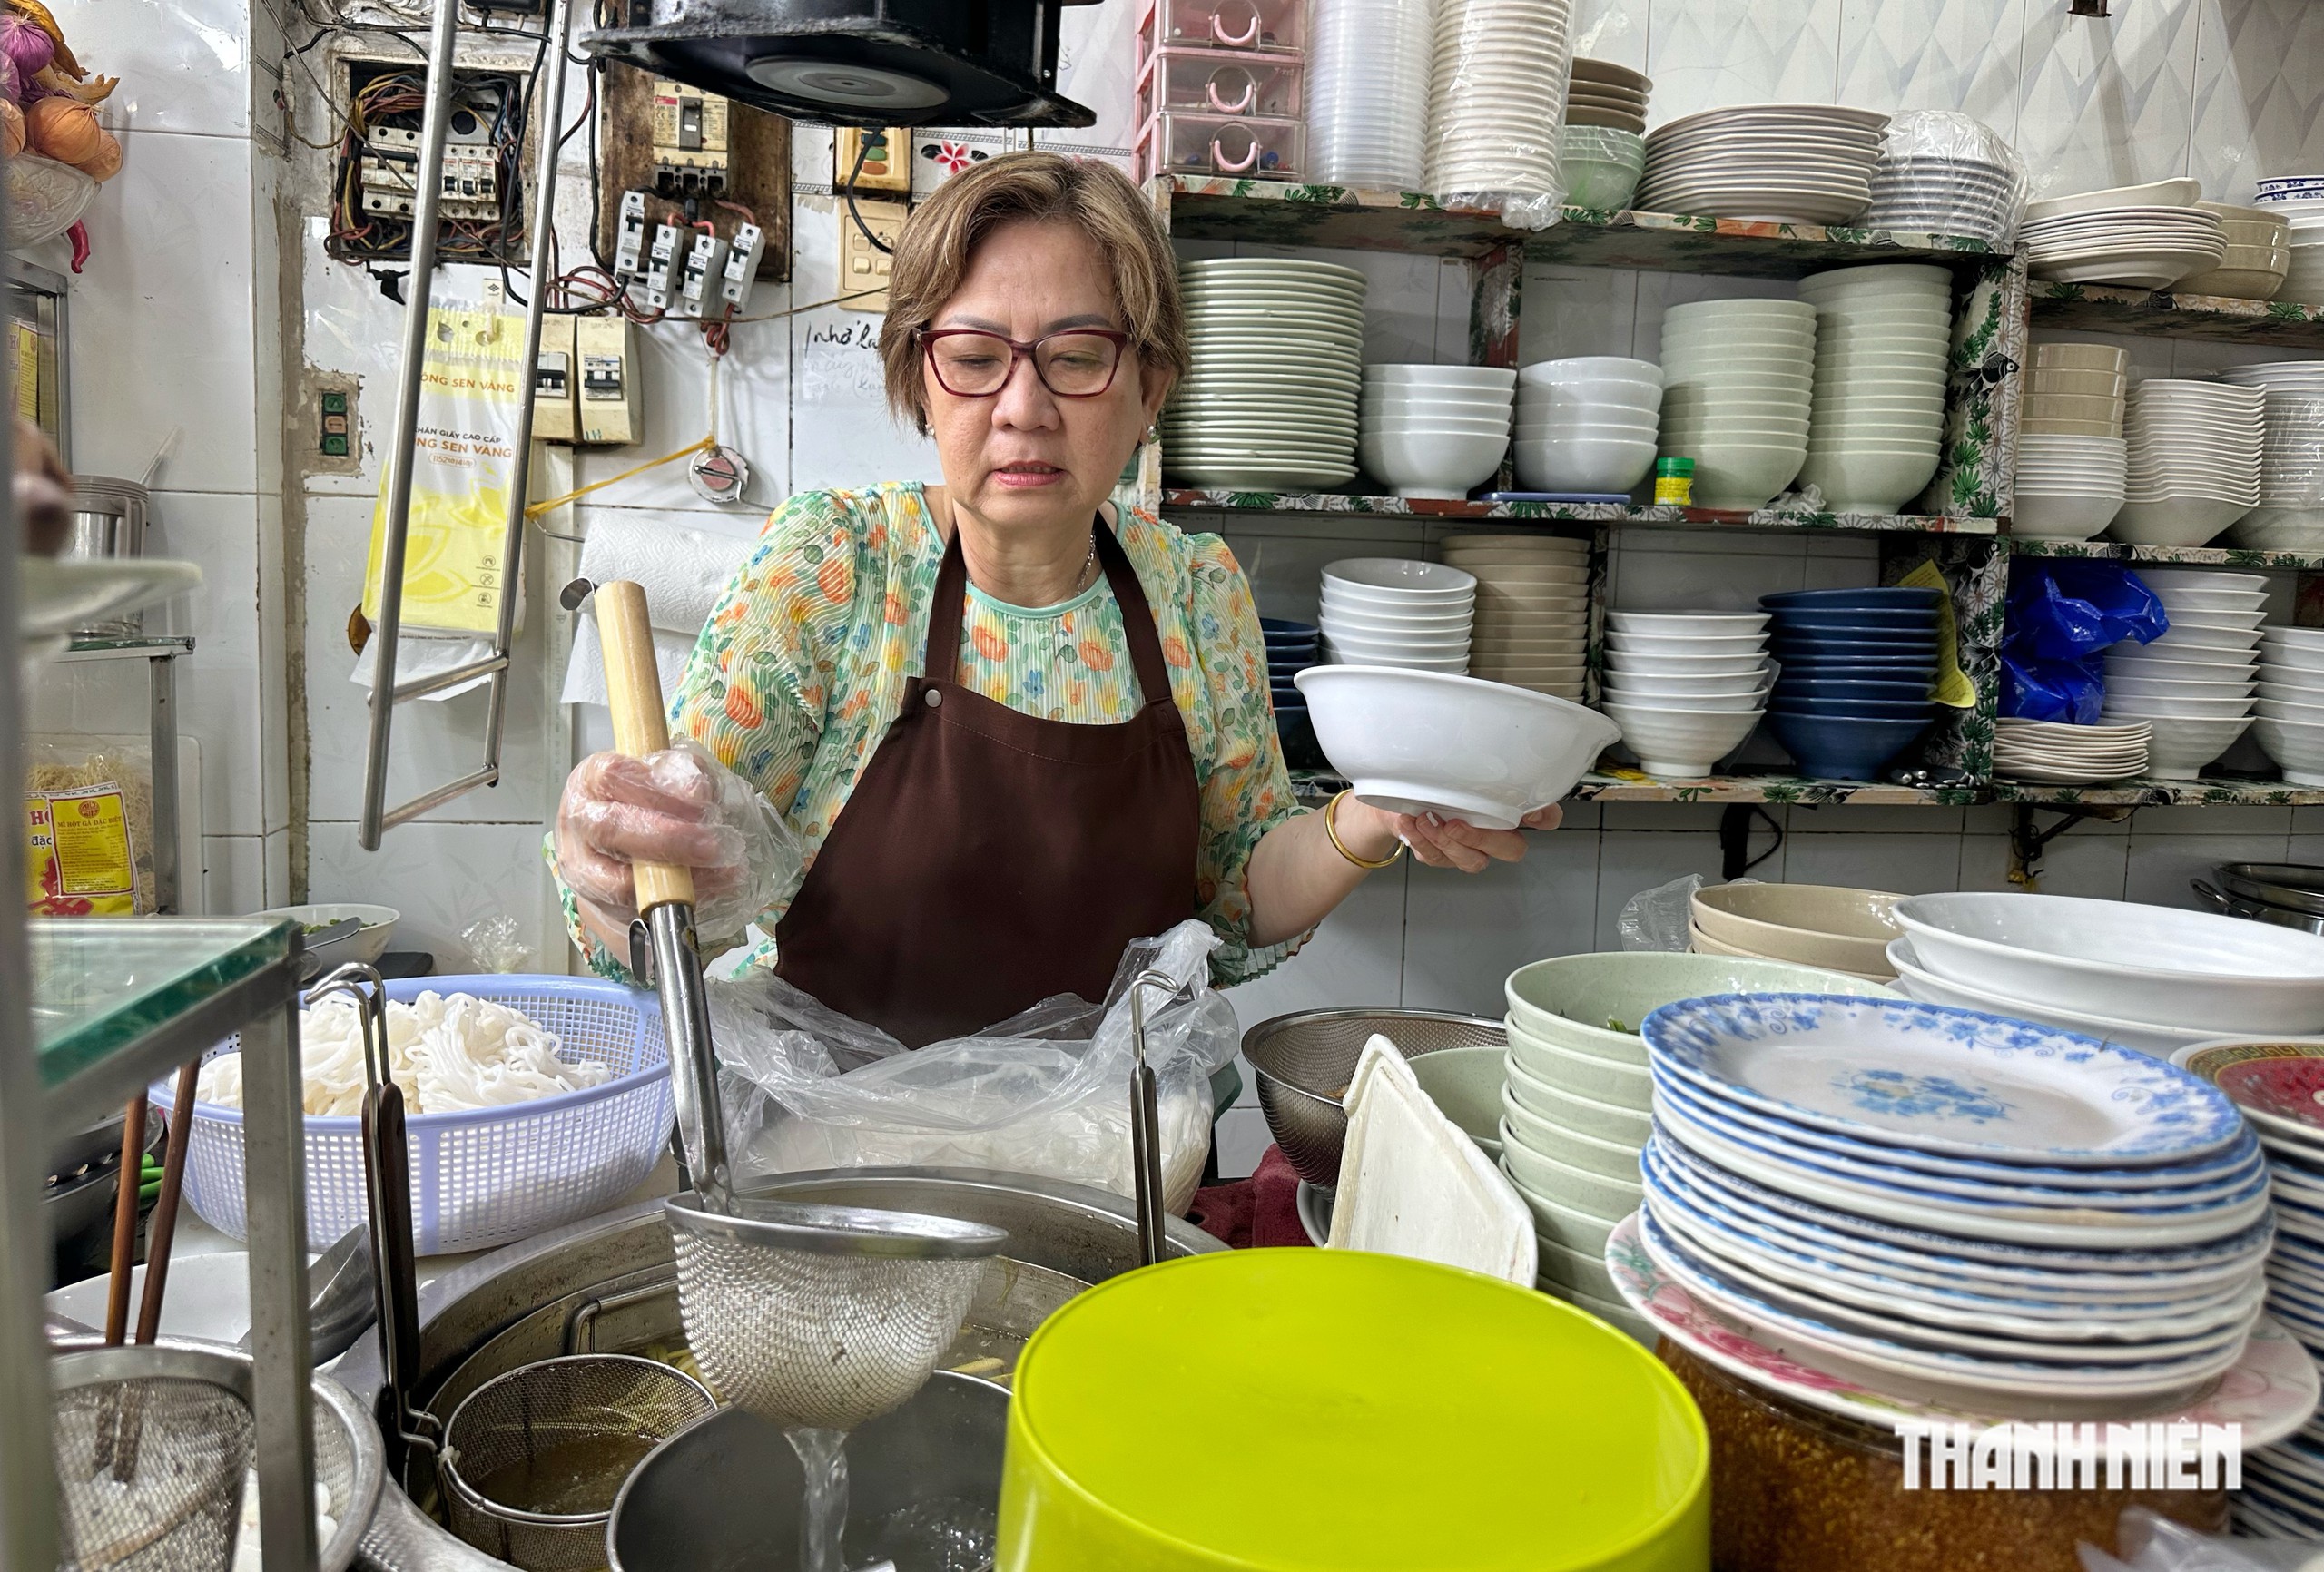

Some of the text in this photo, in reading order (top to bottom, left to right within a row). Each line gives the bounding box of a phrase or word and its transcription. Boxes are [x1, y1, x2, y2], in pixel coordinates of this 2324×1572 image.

[420, 372, 515, 393] ÔNG SEN VÀNG
[462, 433, 481, 441] CAO
[441, 440, 468, 453] SEN
[473, 444, 513, 458] VÀNG
[31, 835, 53, 850] đặc
